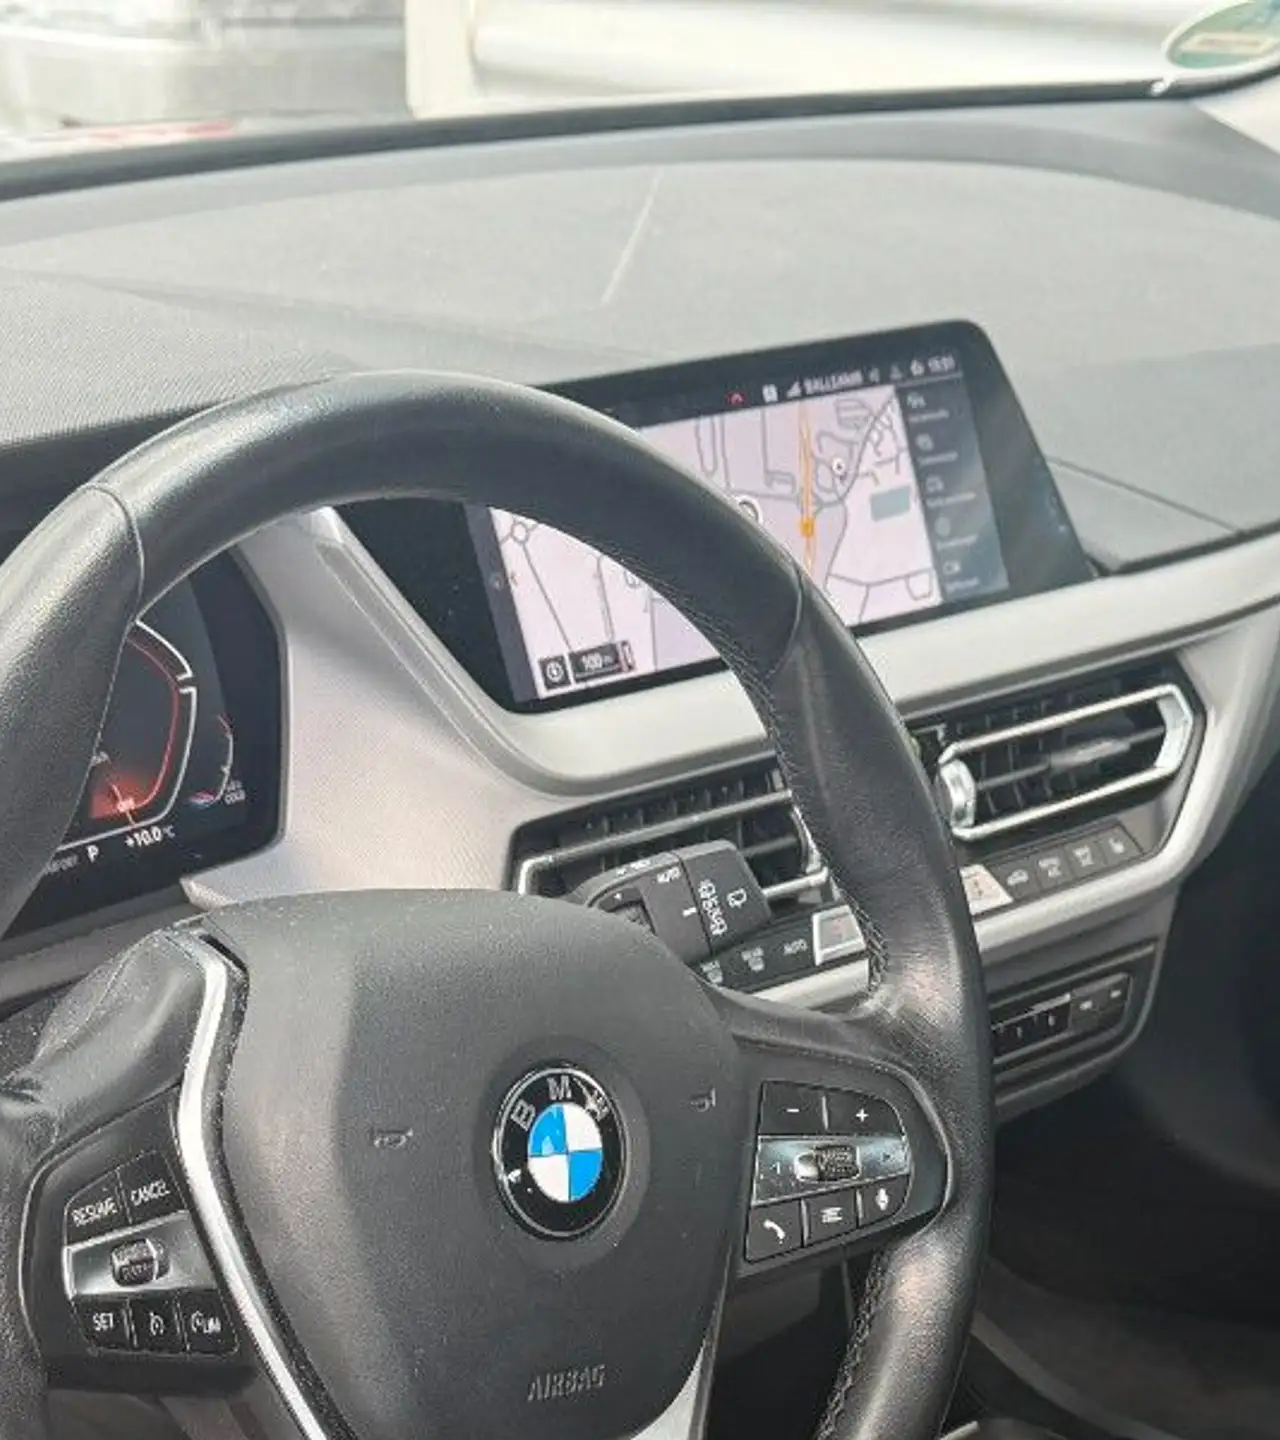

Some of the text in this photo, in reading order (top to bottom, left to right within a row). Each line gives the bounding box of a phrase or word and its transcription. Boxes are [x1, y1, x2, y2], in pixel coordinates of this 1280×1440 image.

[86, 844, 99, 863] P
[510, 1074, 610, 1132] BMW
[131, 1178, 171, 1206] CANCEL
[71, 1196, 119, 1228] RESUME
[92, 1312, 114, 1332] SET
[527, 1363, 607, 1403] AIRBAG
